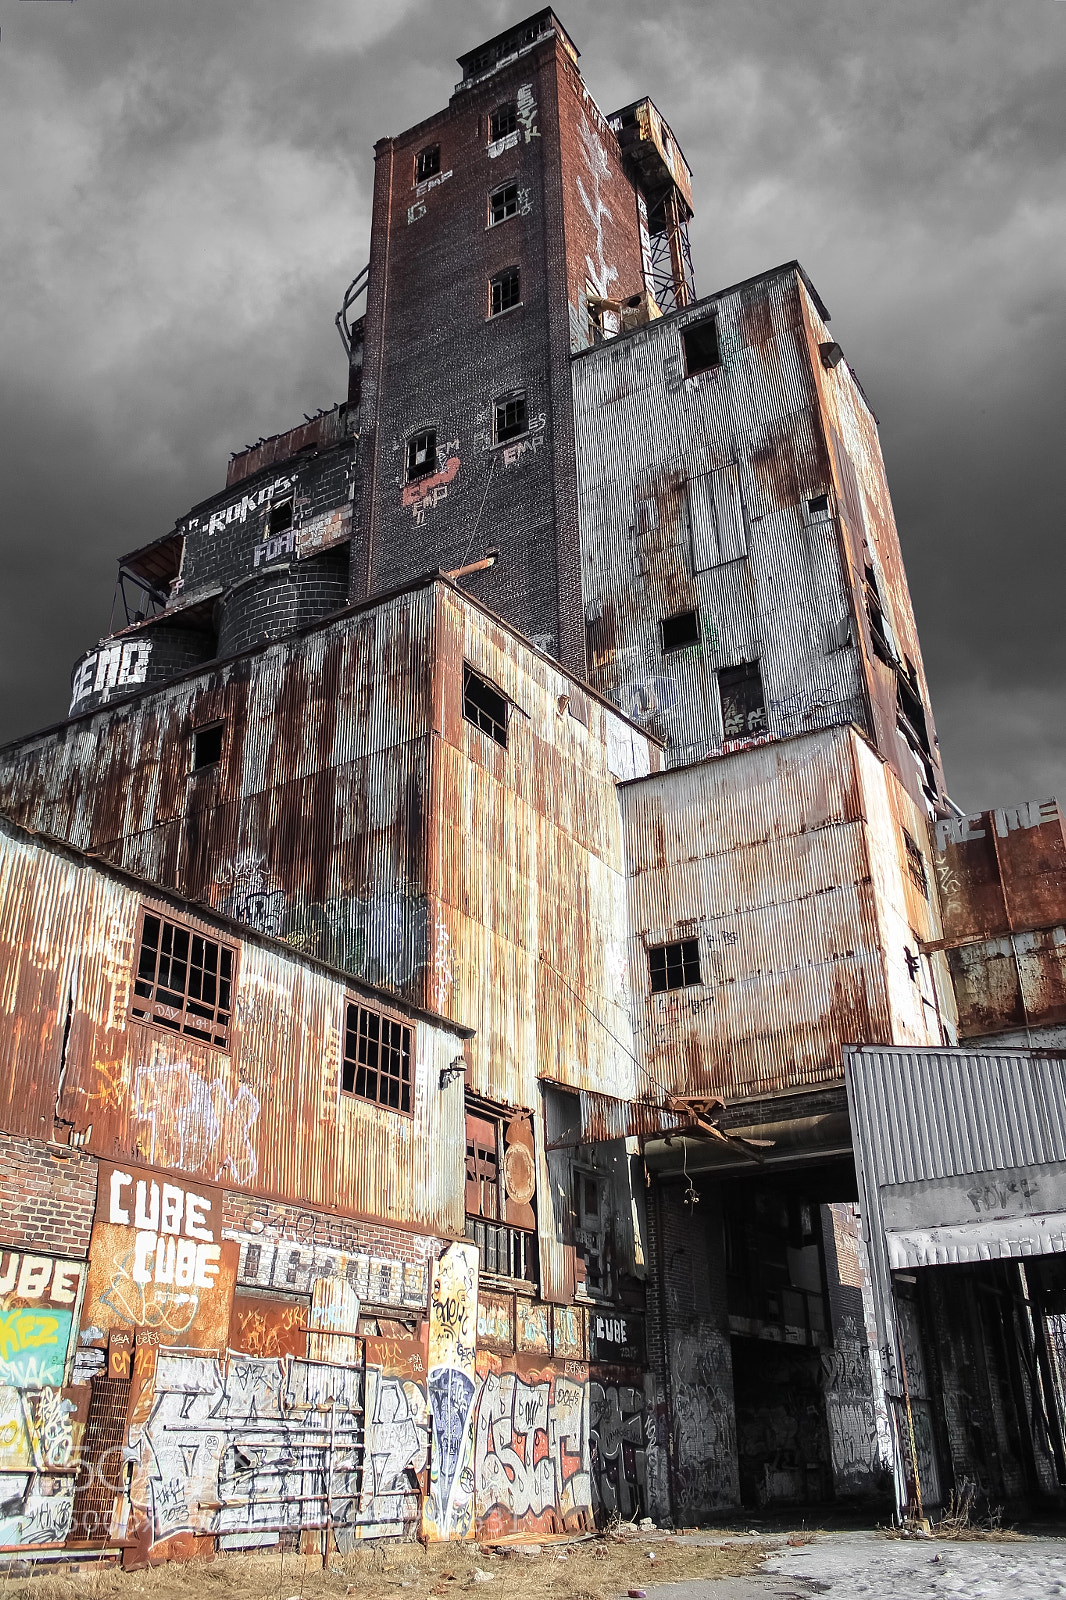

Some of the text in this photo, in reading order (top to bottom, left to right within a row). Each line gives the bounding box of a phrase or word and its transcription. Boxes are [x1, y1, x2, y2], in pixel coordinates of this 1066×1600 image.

[155, 1004, 180, 1021] DAY
[109, 1169, 214, 1242] CUBE
[133, 1230, 222, 1289] CUBE
[596, 1315, 627, 1344] CUBE
